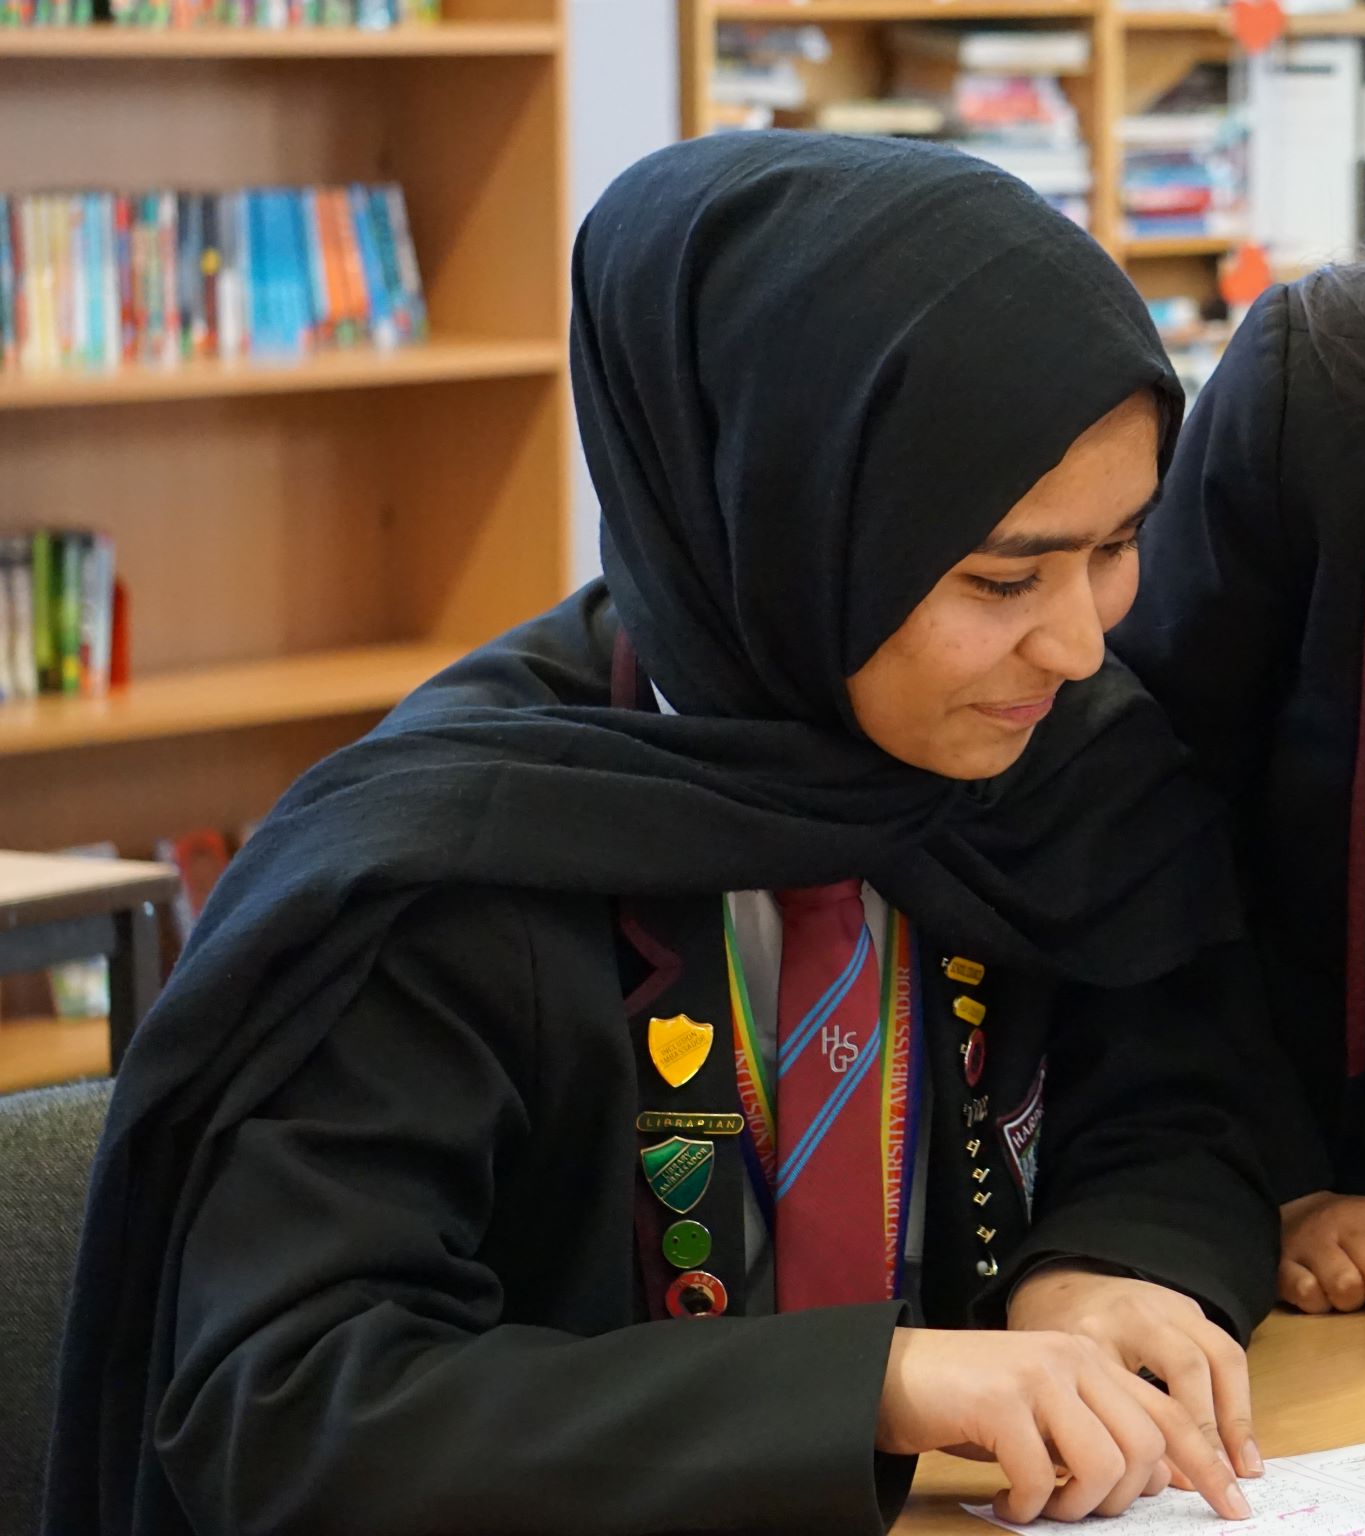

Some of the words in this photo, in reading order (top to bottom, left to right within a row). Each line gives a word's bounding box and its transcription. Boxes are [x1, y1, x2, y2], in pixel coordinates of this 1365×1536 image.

[889, 967, 911, 1116] AMBASSADOR
[646, 1118, 735, 1129] LIBRARIAN
[735, 1049, 771, 1147] INCLUSION
[660, 1147, 708, 1193] AMBASSADOR
[662, 1151, 692, 1178] LIBRARY
[886, 1112, 906, 1218] DIVERSITY
